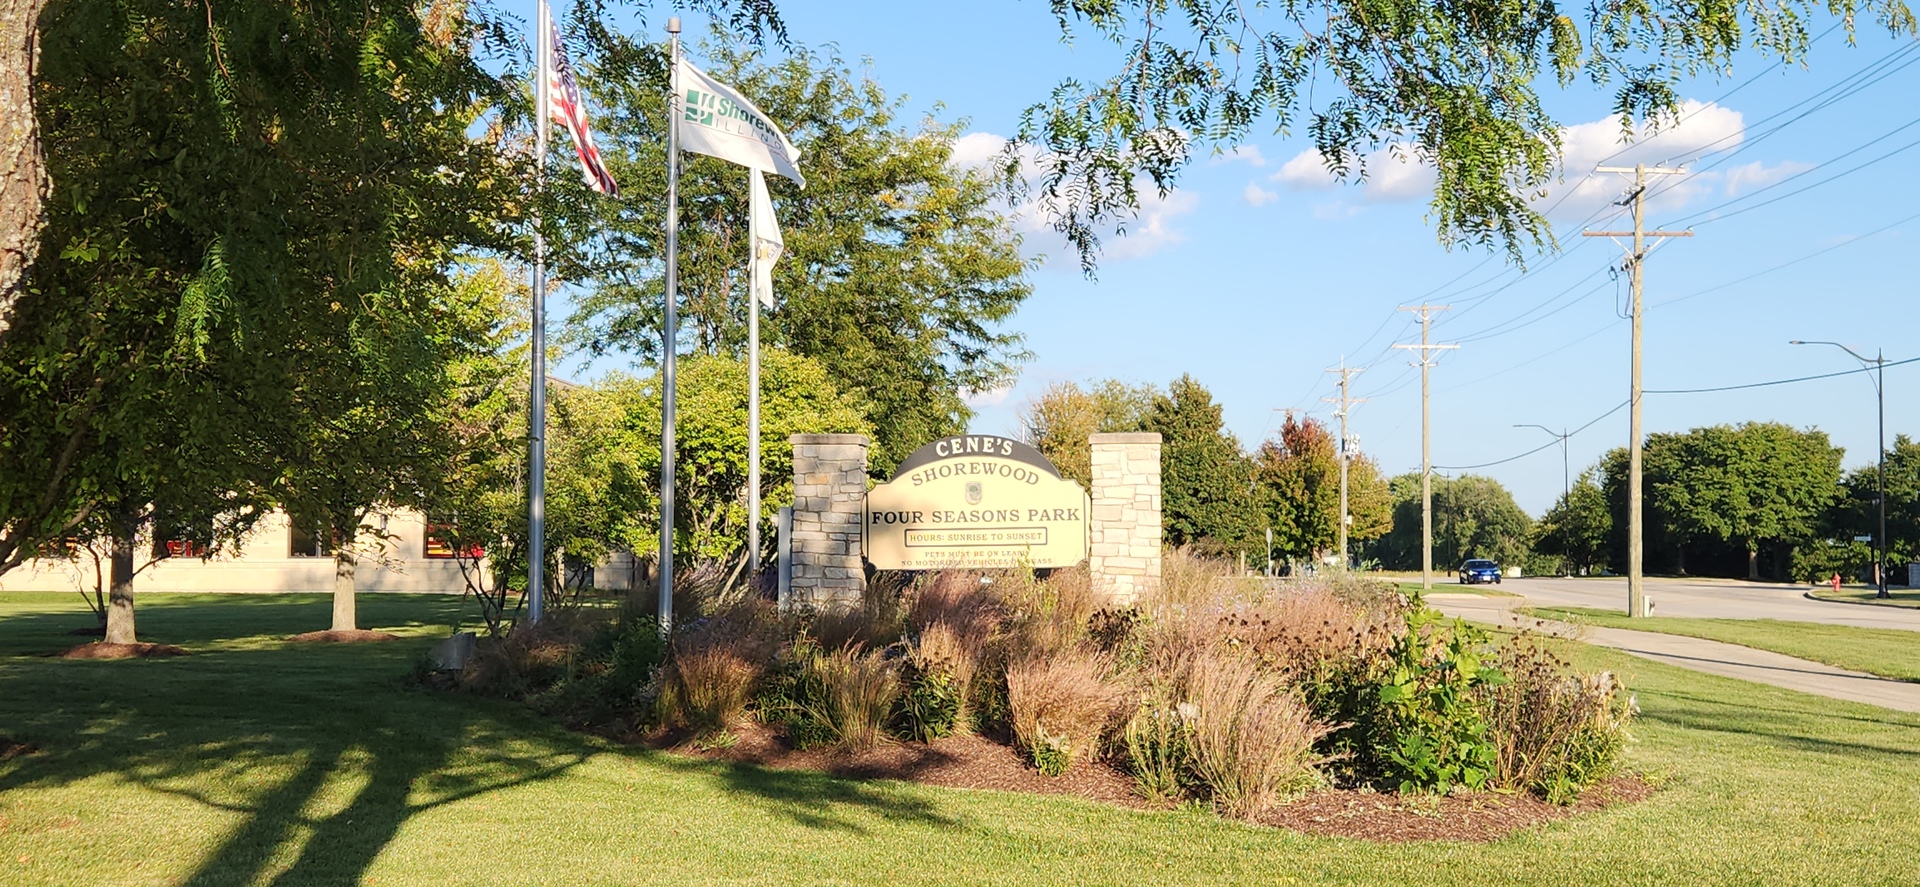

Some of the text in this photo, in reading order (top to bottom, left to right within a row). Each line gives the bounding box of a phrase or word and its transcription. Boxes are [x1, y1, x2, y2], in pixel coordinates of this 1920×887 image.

[936, 436, 1014, 457] CENE'S
[911, 462, 1040, 487] SHOREWOOD
[871, 508, 1081, 525] FOUR SEASONS PARK
[909, 532, 1042, 542] HOURS: SUNRISE TO SUNSET
